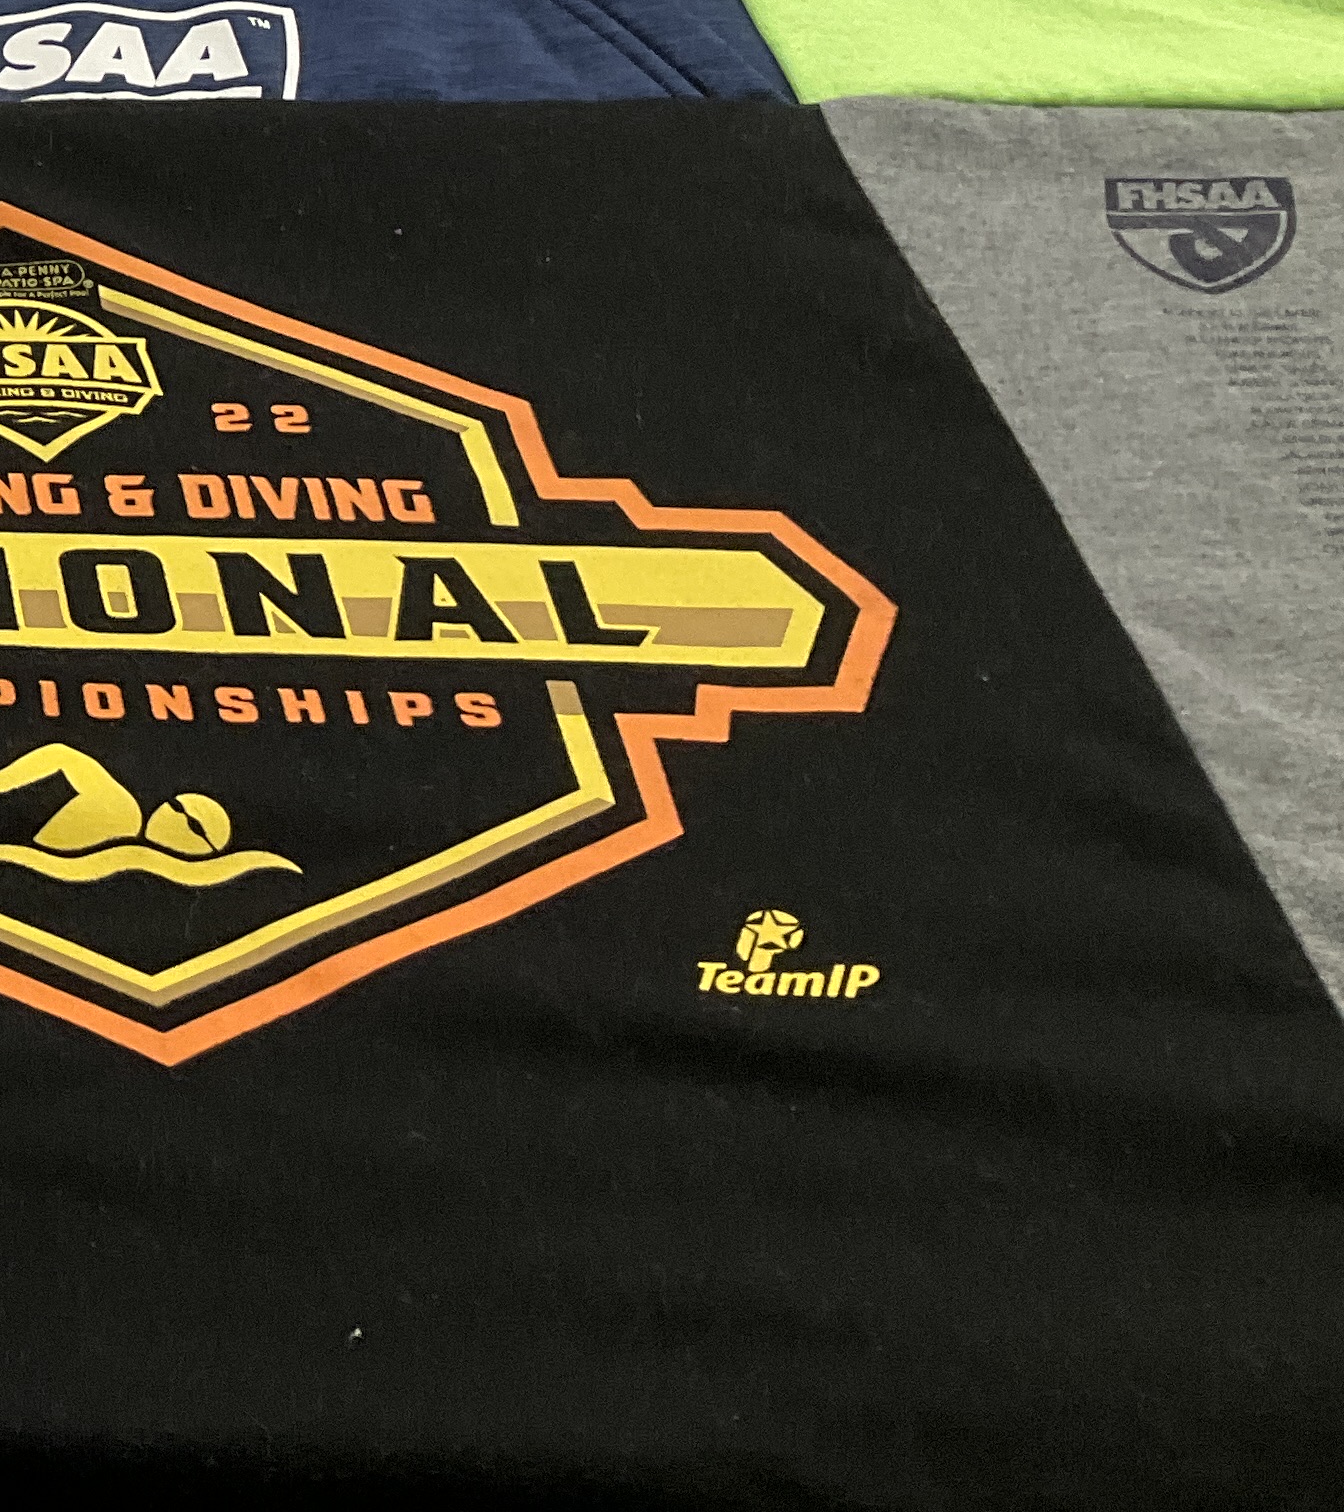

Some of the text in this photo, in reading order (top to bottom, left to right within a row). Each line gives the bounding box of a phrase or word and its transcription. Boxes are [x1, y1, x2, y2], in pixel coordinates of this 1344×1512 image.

[1117, 180, 1280, 210] FHSAA
[40, 388, 55, 399] &
[61, 389, 129, 404] DIVING
[210, 401, 313, 437] 22
[106, 475, 154, 518] &
[185, 472, 437, 525] DIVING
[696, 958, 881, 1006] TeamIP
